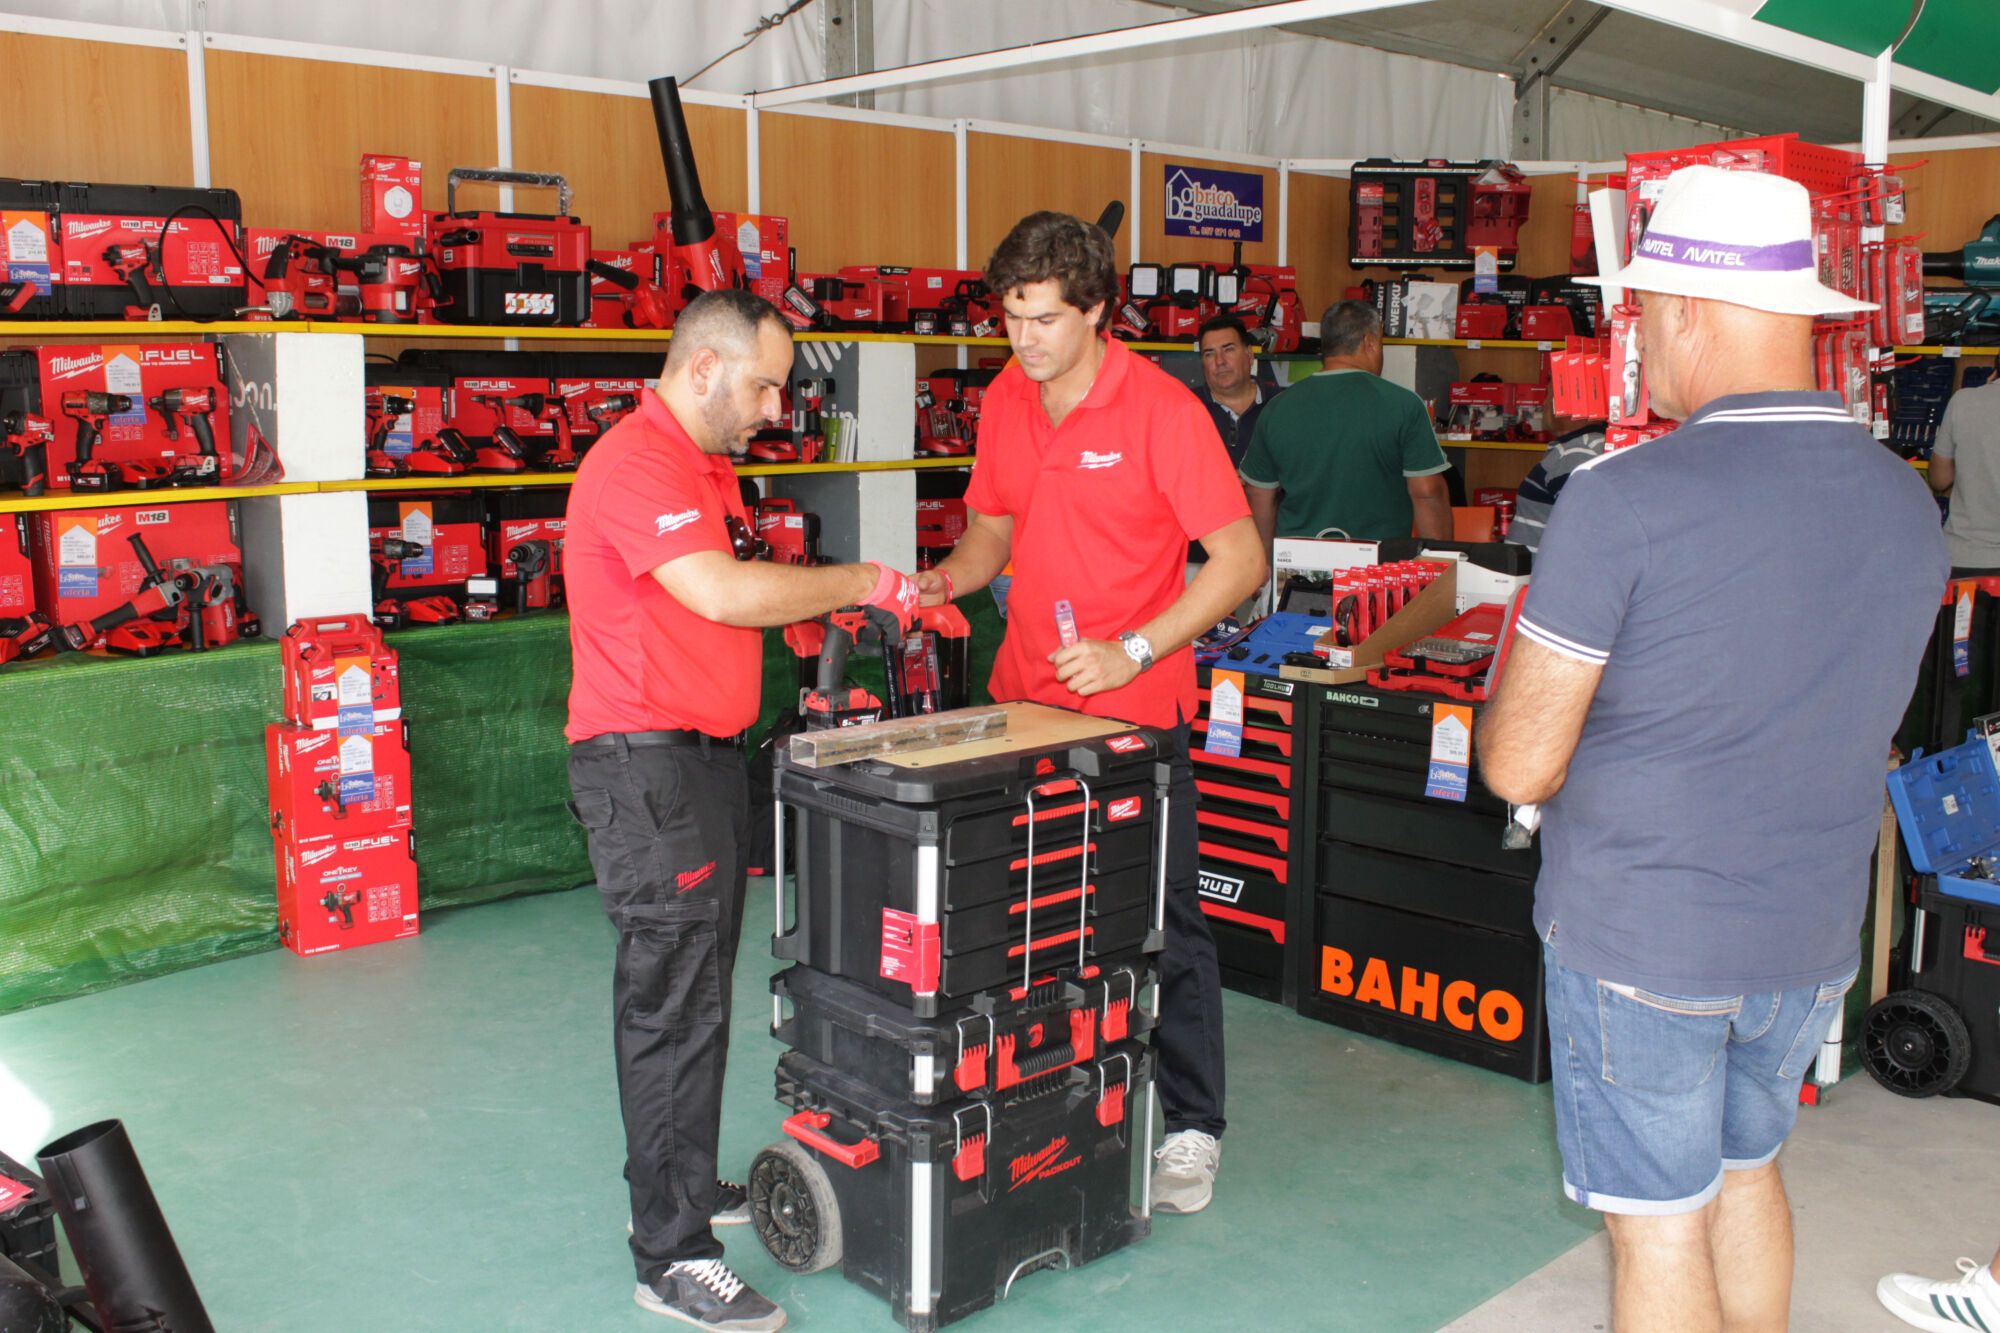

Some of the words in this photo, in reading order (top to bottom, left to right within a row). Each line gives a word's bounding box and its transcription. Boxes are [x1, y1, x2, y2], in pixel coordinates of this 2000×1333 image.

[1194, 182, 1235, 206] brico
[1194, 201, 1262, 226] guadalupe
[67, 219, 112, 235] Milwaukee
[327, 237, 353, 248] M18
[1682, 246, 1745, 266] AVATEL
[1390, 284, 1401, 327] WERKU
[49, 352, 104, 374] Milwauke
[145, 349, 204, 361] FUEL
[480, 380, 516, 388] FUEL
[138, 512, 166, 523] M18
[655, 508, 700, 530] Milwaukee
[1326, 691, 1359, 705] BAHCO
[361, 835, 400, 847] FUEL
[1321, 945, 1523, 1042] BAHCO
